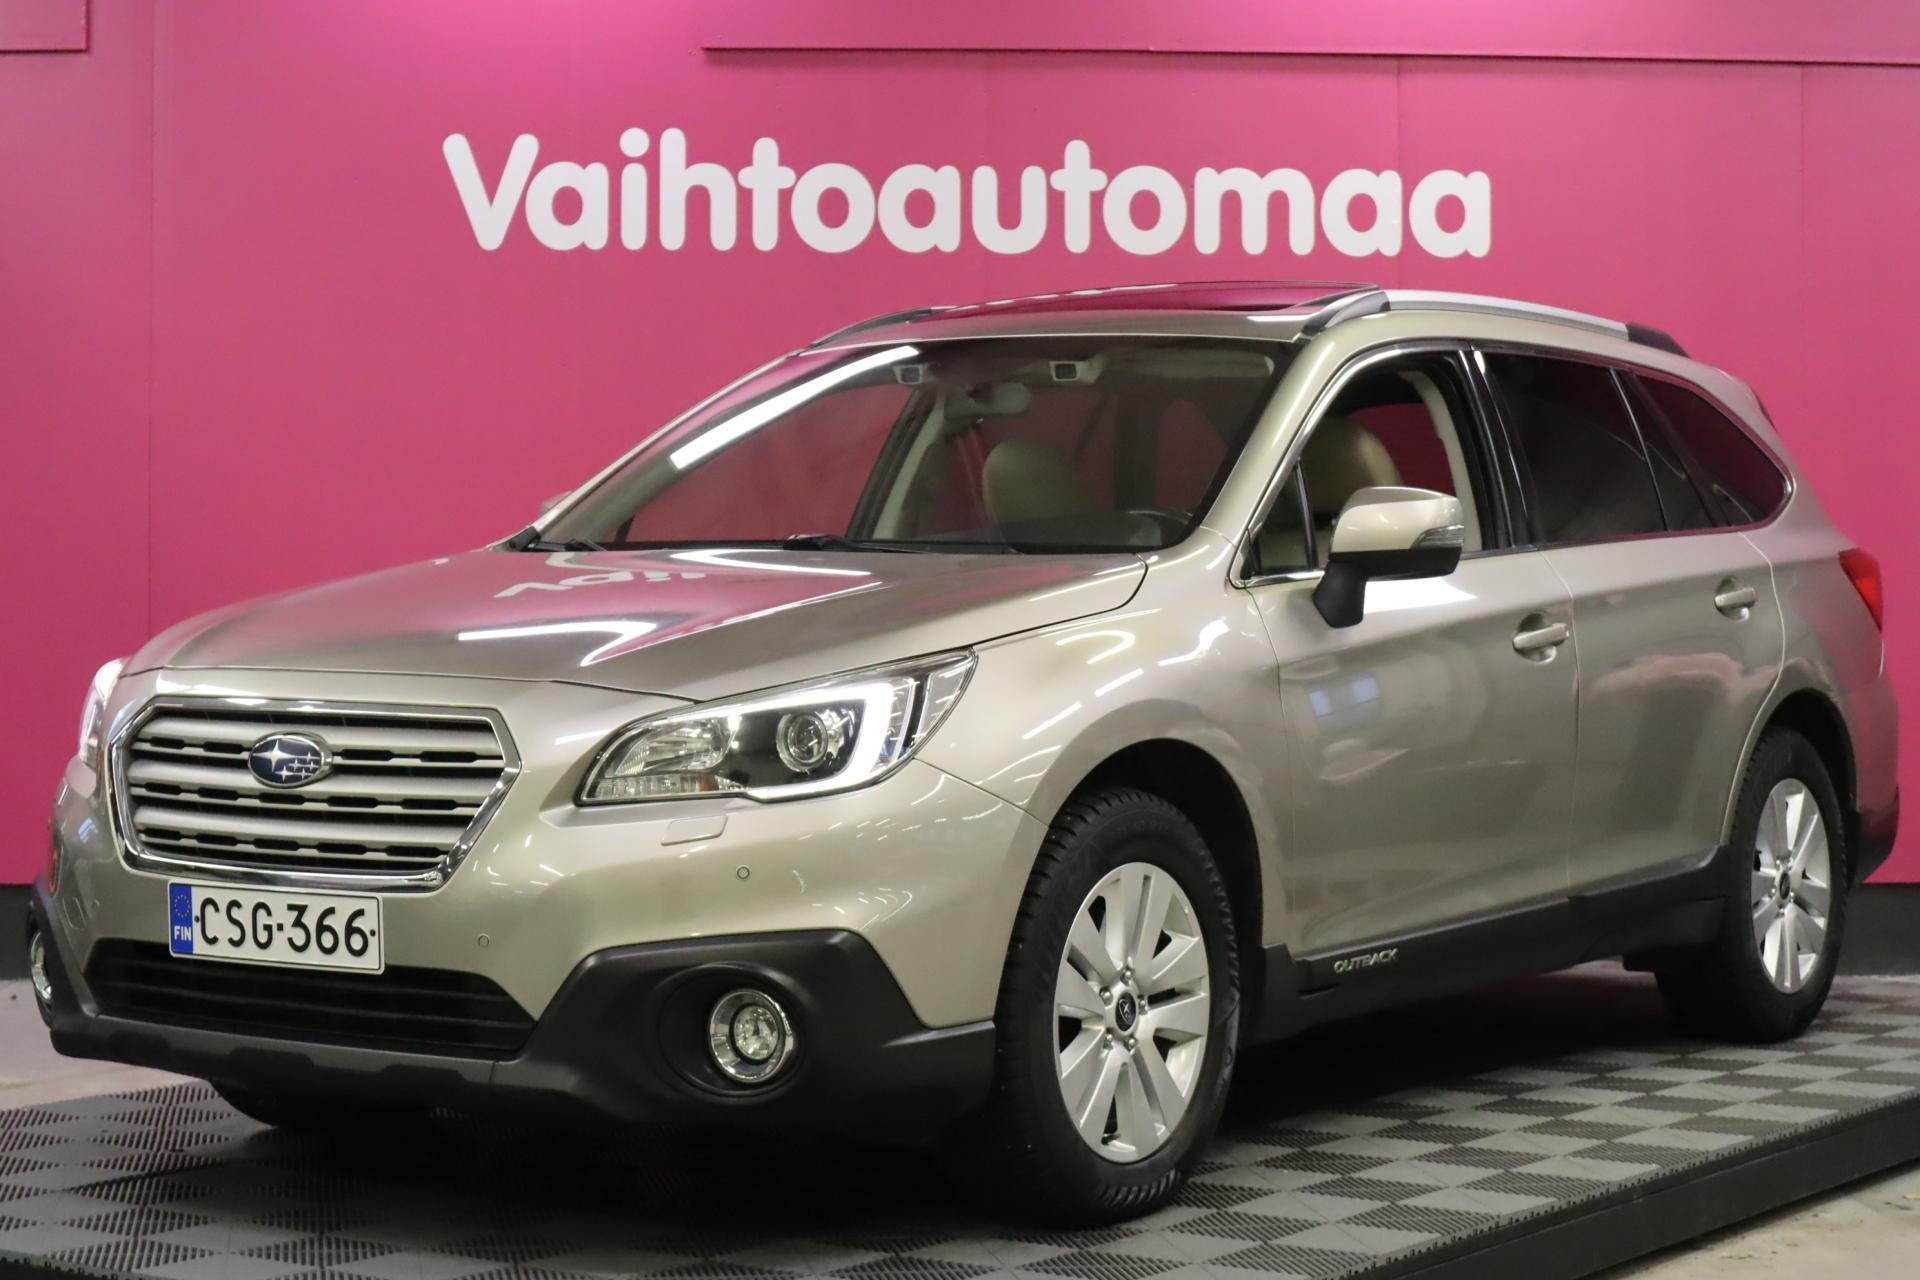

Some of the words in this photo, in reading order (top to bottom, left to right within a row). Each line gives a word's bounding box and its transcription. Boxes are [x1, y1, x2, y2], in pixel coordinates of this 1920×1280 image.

[442, 127, 1492, 258] Vaihtoautomaa
[174, 925, 192, 942] FIN
[200, 897, 369, 957] CSG-366
[1334, 948, 1398, 973] OUTBACK
